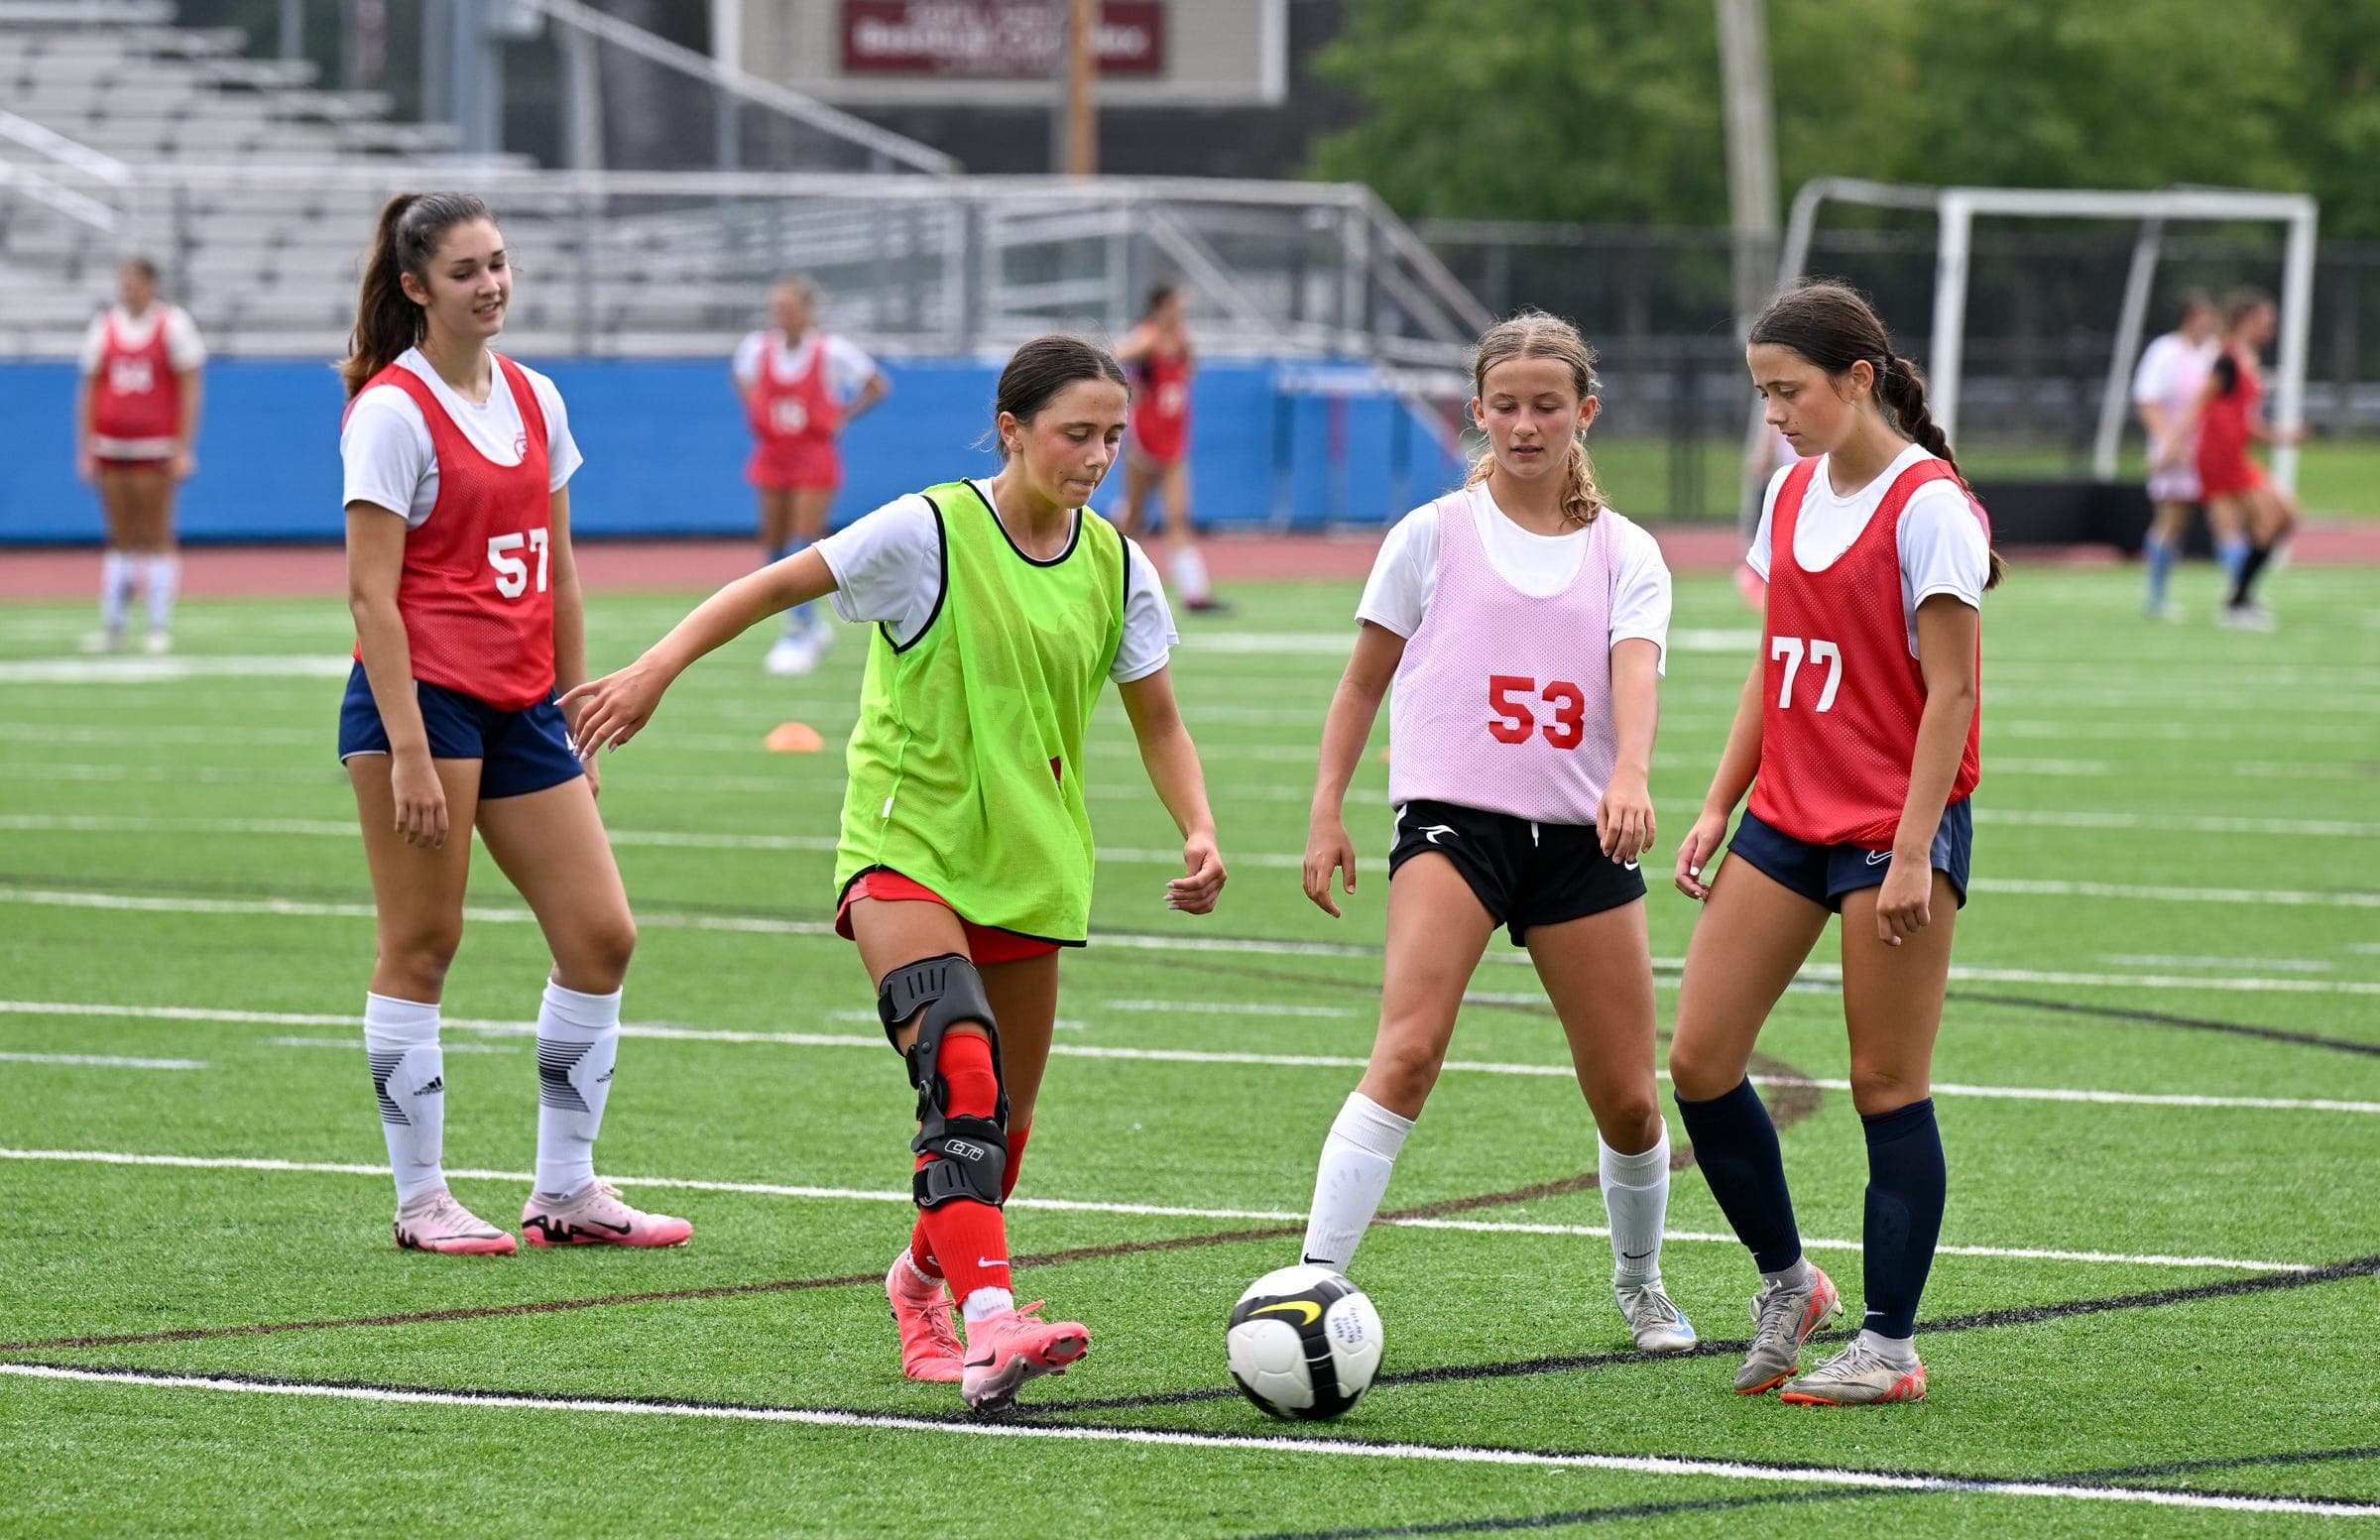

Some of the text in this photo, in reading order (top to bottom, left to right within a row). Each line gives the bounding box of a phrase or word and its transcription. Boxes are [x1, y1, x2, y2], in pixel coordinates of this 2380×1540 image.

[487, 527, 549, 599] 57
[1488, 674, 1585, 750] 53
[1771, 636, 1843, 712] 77
